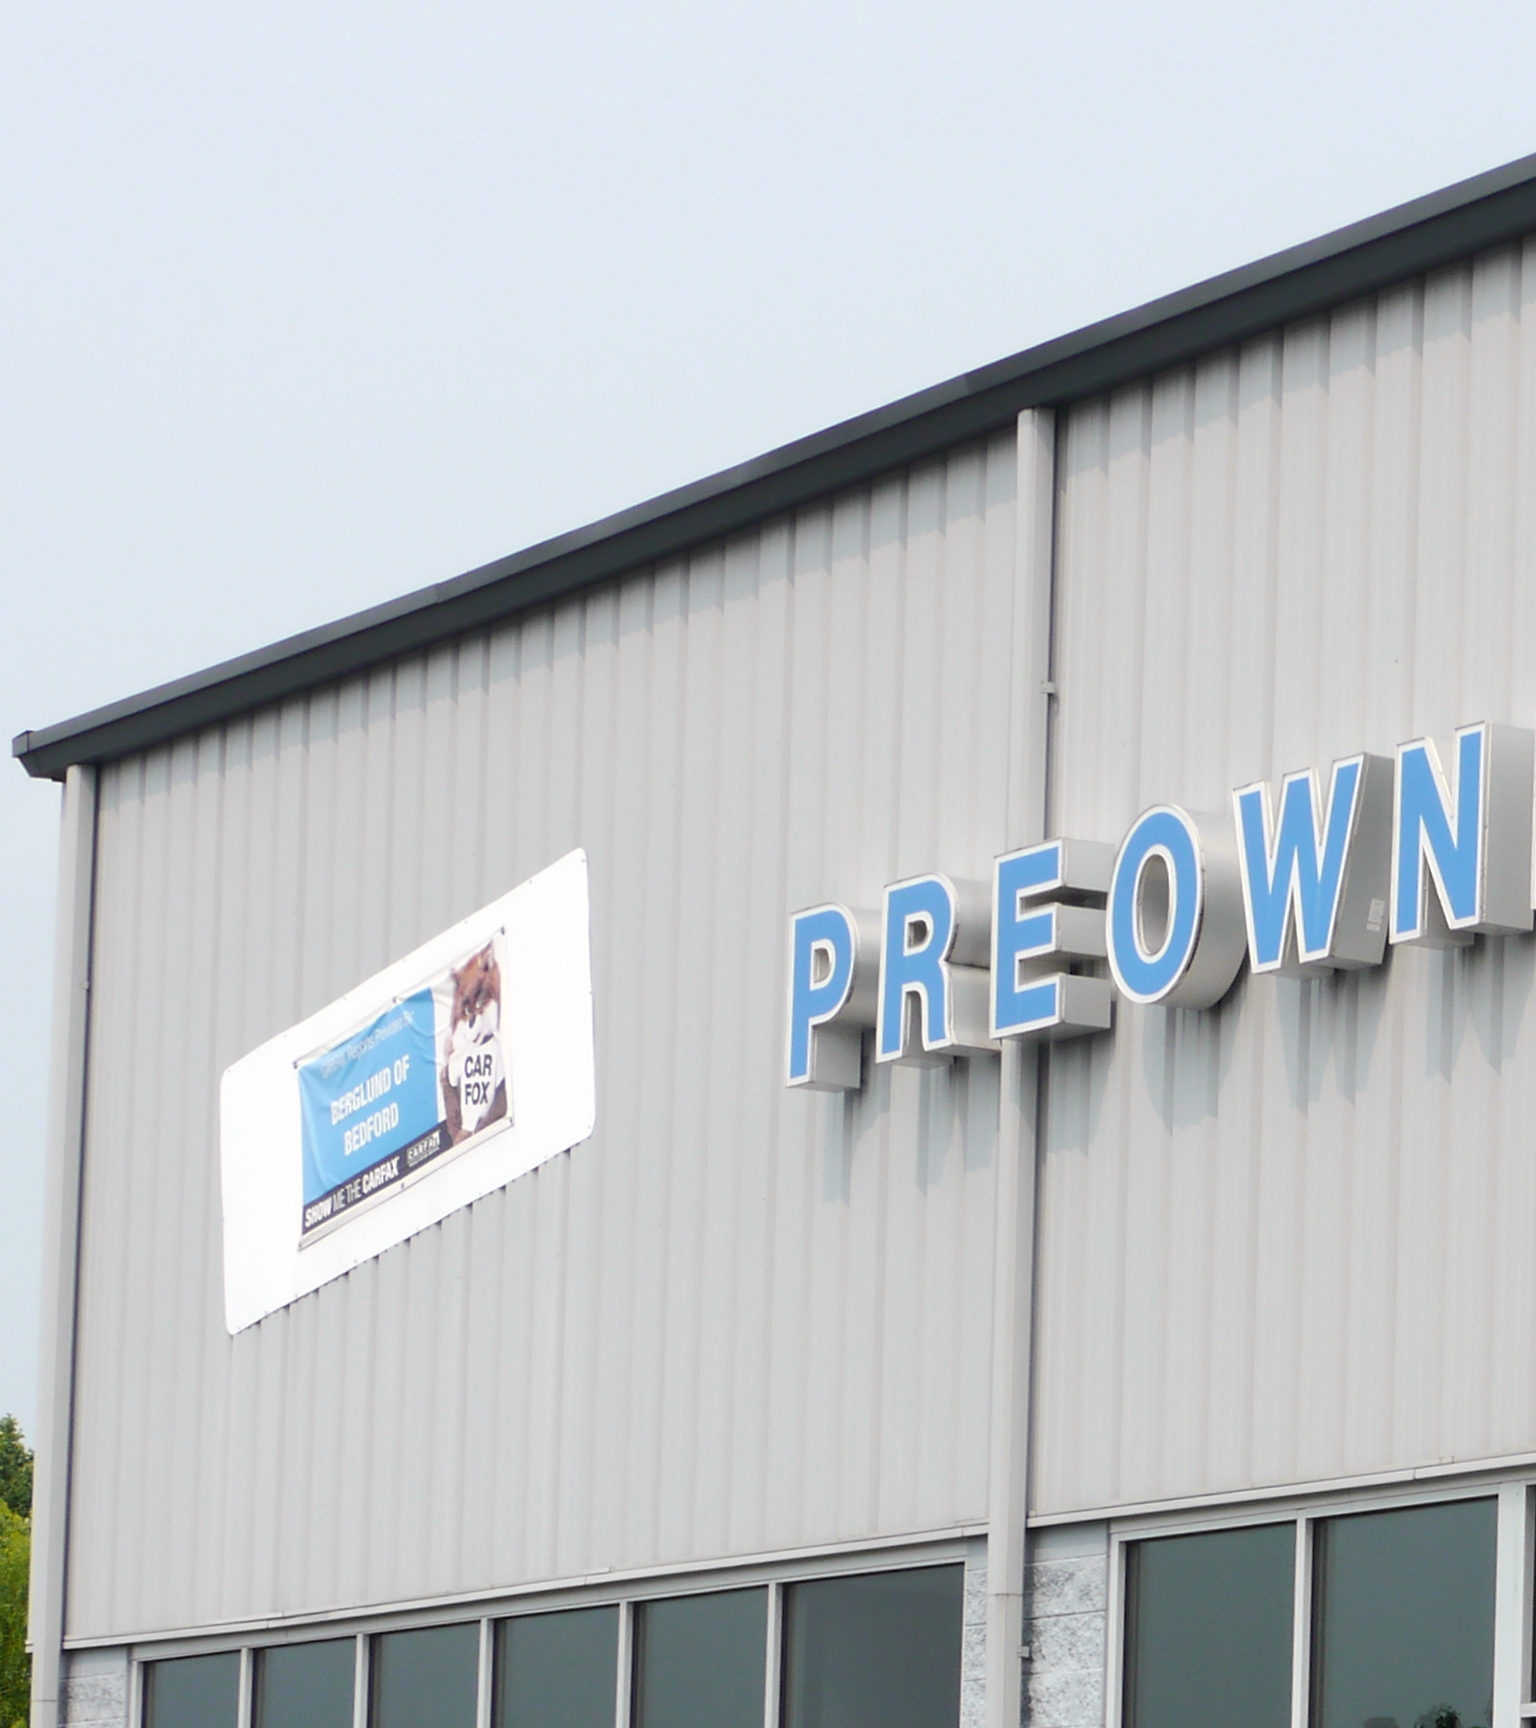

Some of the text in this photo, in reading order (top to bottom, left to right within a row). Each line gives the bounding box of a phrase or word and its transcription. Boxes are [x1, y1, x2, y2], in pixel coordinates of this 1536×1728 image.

[331, 1054, 410, 1125] BERGLUND OF
[464, 1054, 493, 1079] CAR
[465, 1081, 490, 1105] FOX
[344, 1102, 399, 1156] BEDFORD
[305, 1196, 332, 1228] SHOW
[332, 1188, 346, 1212] ME
[346, 1178, 362, 1204] THE
[362, 1155, 400, 1195] CARFAX
